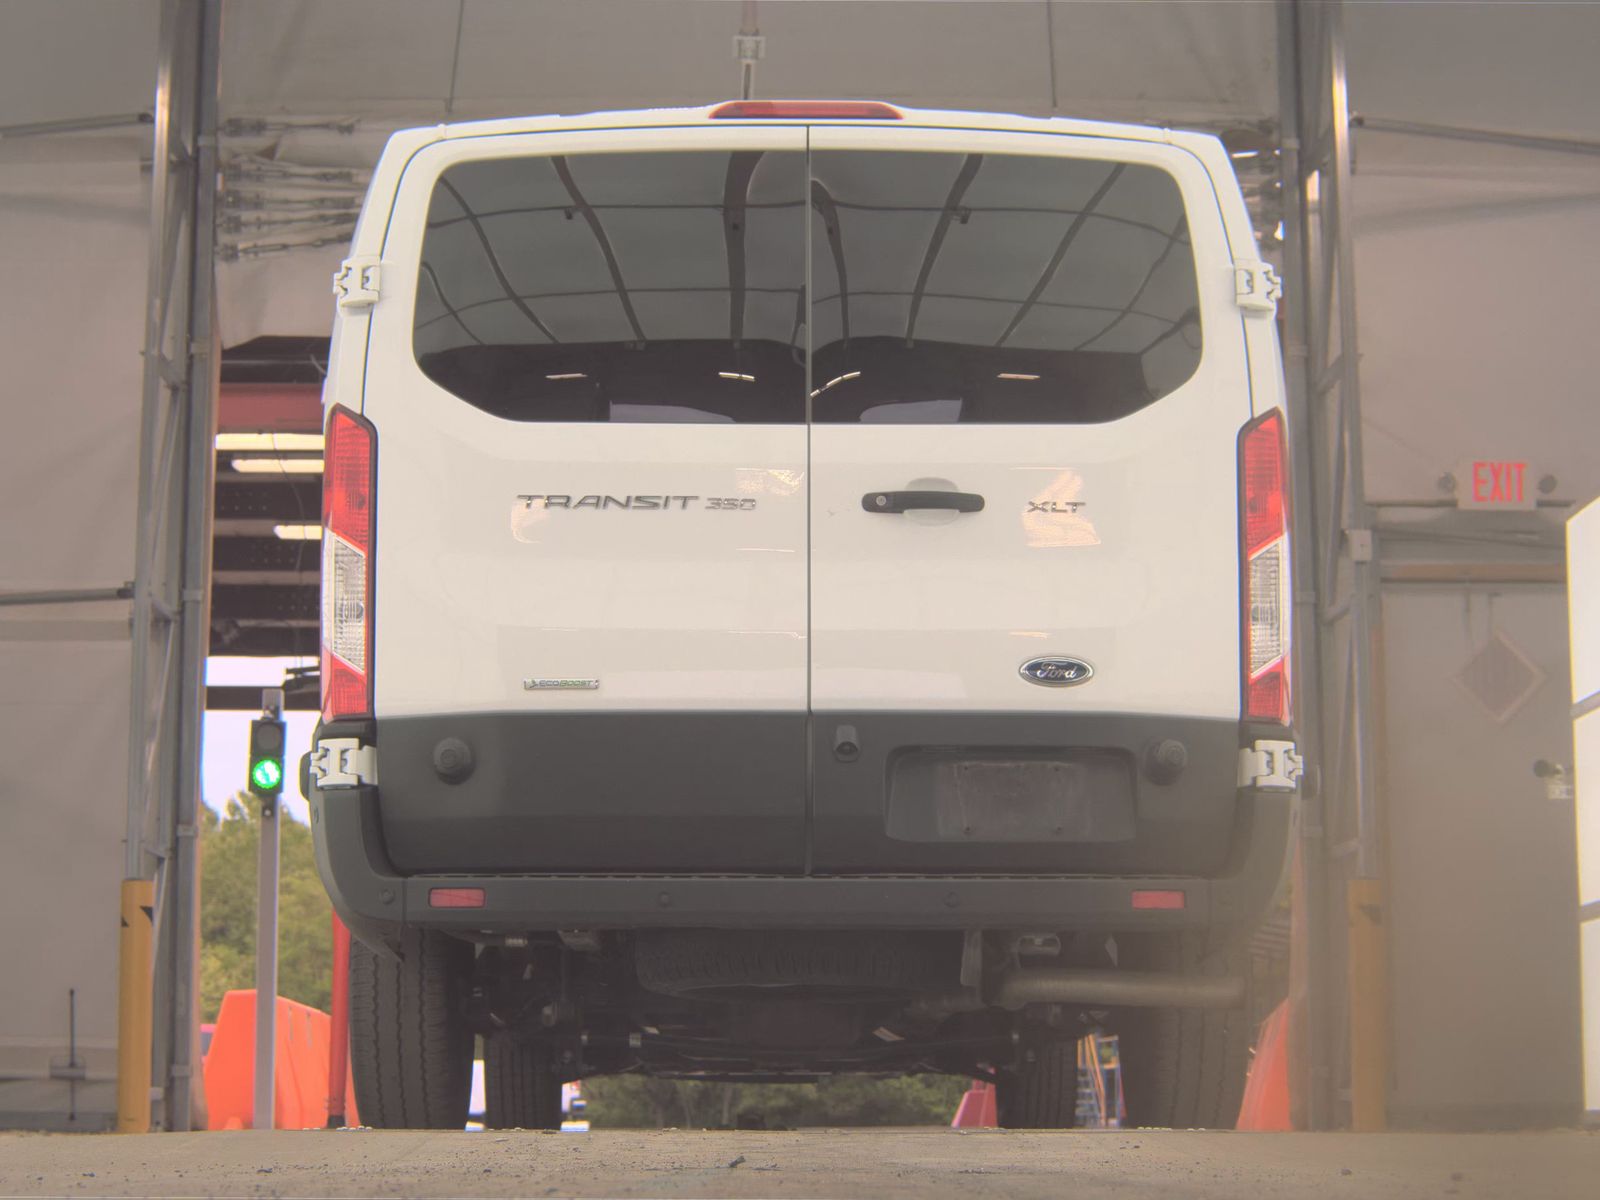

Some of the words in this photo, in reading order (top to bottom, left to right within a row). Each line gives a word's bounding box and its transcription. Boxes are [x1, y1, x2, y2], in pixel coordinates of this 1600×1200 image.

[1472, 462, 1527, 502] EXIT
[517, 495, 699, 510] TRANSIT
[705, 498, 756, 511] 350
[1027, 501, 1086, 513] XLT
[1036, 661, 1077, 678] Ford
